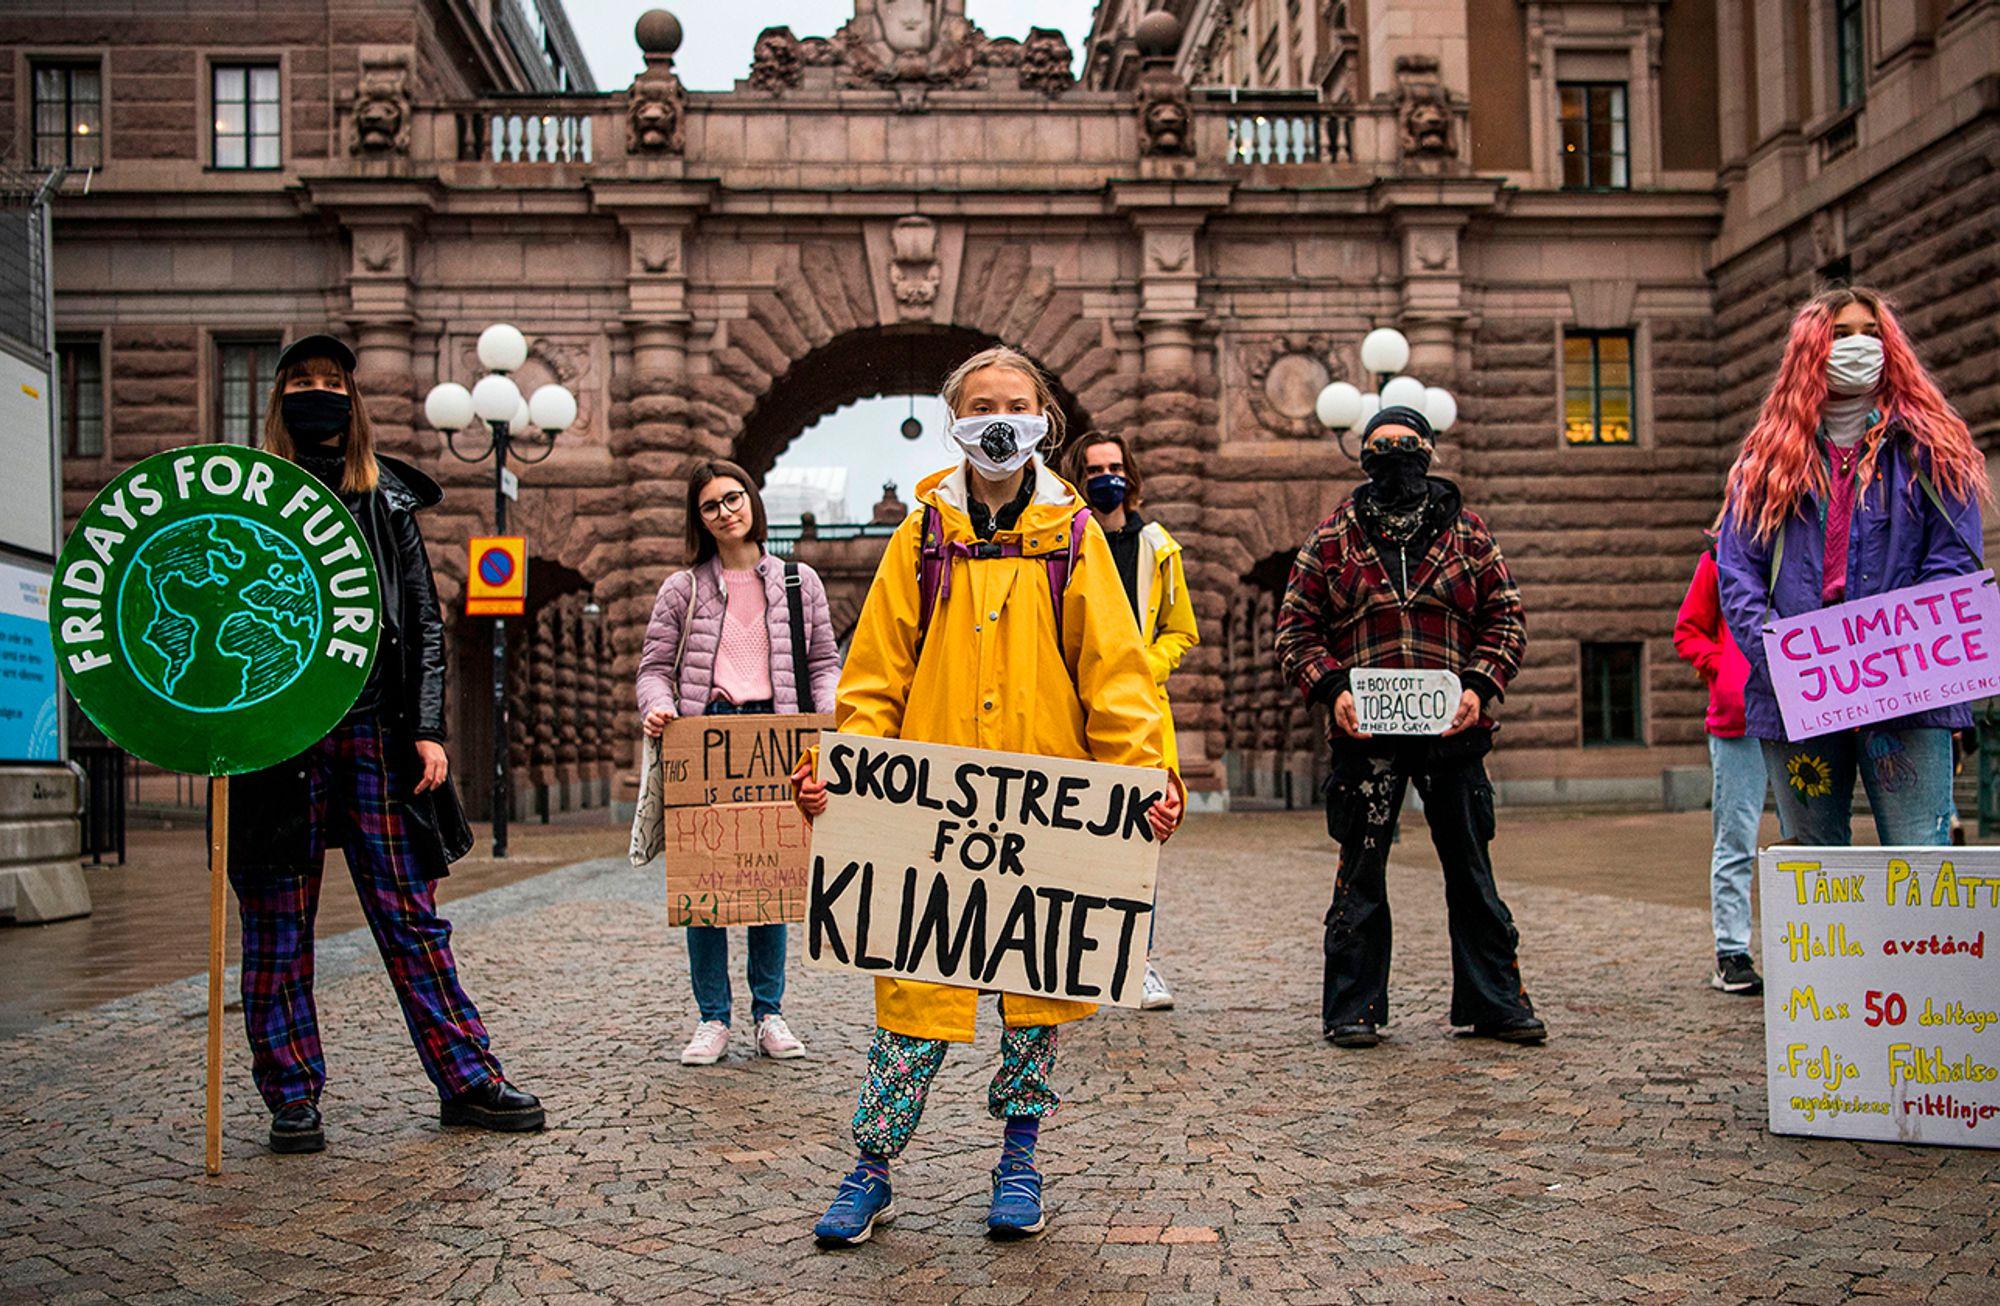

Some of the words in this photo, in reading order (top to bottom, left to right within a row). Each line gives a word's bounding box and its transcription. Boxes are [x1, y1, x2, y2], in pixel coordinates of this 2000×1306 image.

[61, 473, 162, 673] FRIDAYS
[174, 455, 274, 506] FOR
[280, 484, 374, 668] FUTURE
[1780, 588, 1982, 660] CLIMATE
[1799, 629, 1988, 701] JUSTICE
[1361, 690, 1446, 721] TOBACCO
[1801, 704, 1869, 732] LISTEN
[1875, 697, 1899, 714] TO
[1903, 689, 1931, 706] THE
[1940, 676, 2000, 698] SCIENC
[664, 759, 689, 783] THIS
[703, 728, 837, 780] PLANE
[704, 787, 718, 803] IS
[824, 744, 1163, 841] SKOLSTREJK
[734, 852, 779, 868] THAN
[934, 819, 1025, 876] FÖR
[696, 869, 725, 890] MY
[809, 855, 1153, 1002] KLIMATET
[1787, 922, 1864, 962] Hålla
[1883, 931, 1984, 959] avstånd
[1789, 985, 1850, 1021] Max
[1864, 990, 1907, 1027] 50
[1919, 997, 2000, 1033] deltaga
[1787, 1043, 1860, 1091] Följa
[1887, 1043, 1998, 1087] Folkhälso
[1903, 1093, 2000, 1129] riktlinjer
